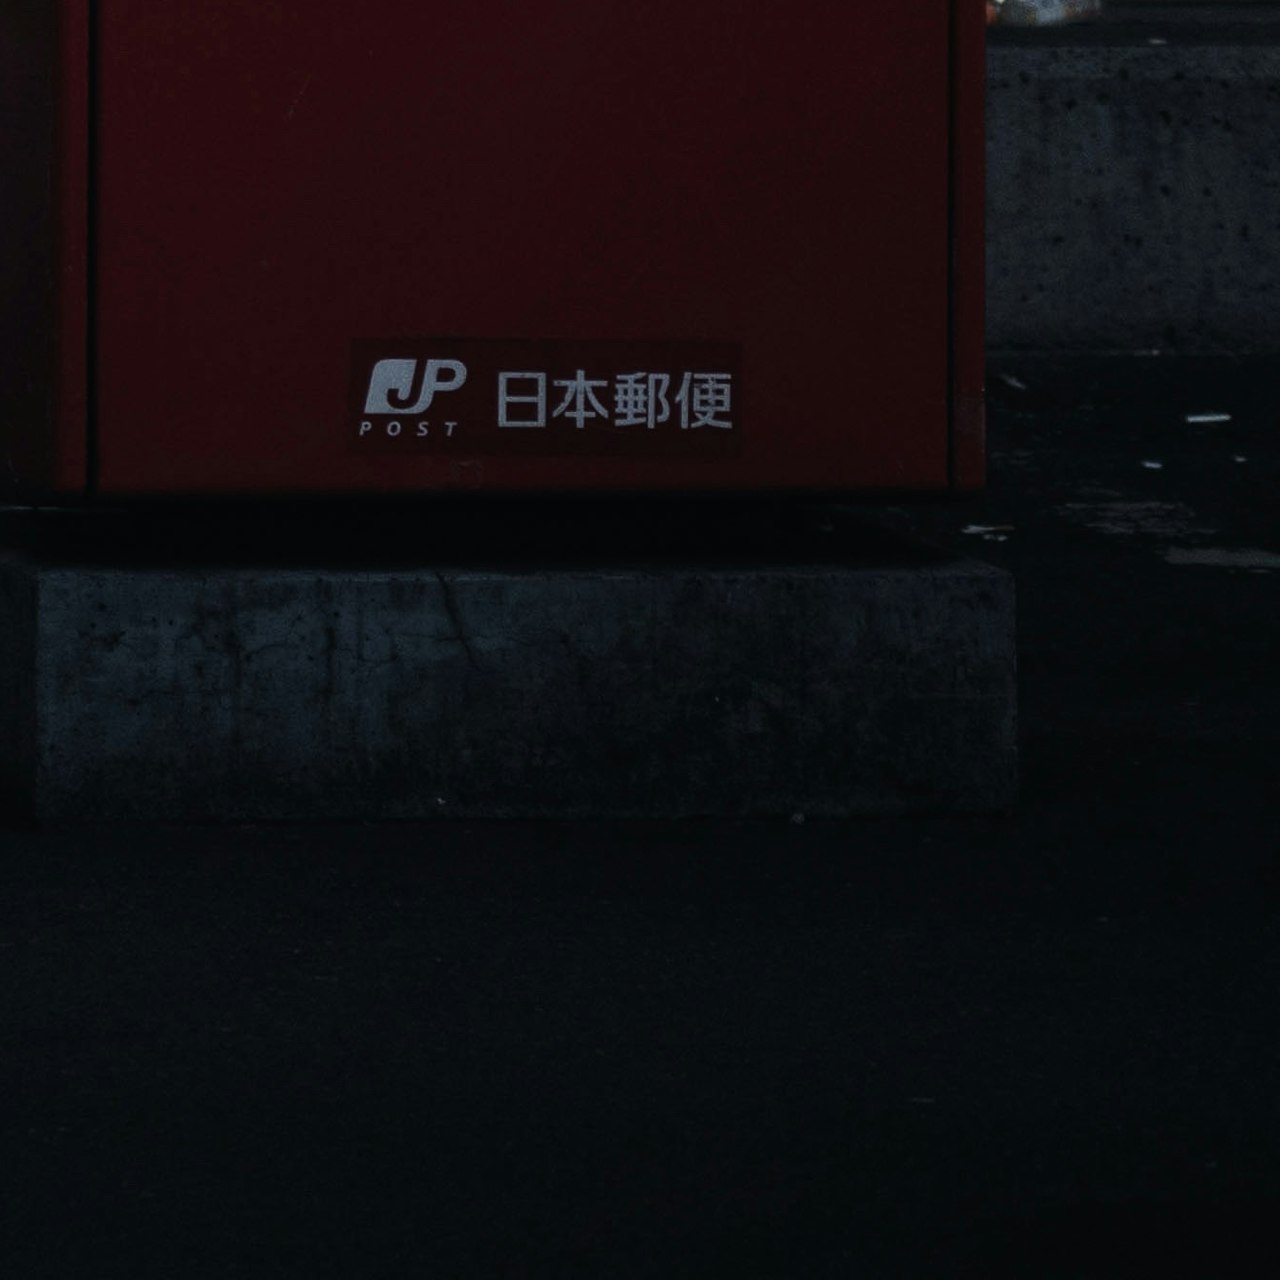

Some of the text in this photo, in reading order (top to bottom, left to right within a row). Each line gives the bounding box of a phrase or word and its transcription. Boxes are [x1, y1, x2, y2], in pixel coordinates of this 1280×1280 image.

[363, 357, 468, 415] JP
[497, 368, 734, 431] 日本郵便
[358, 420, 459, 438] POST
